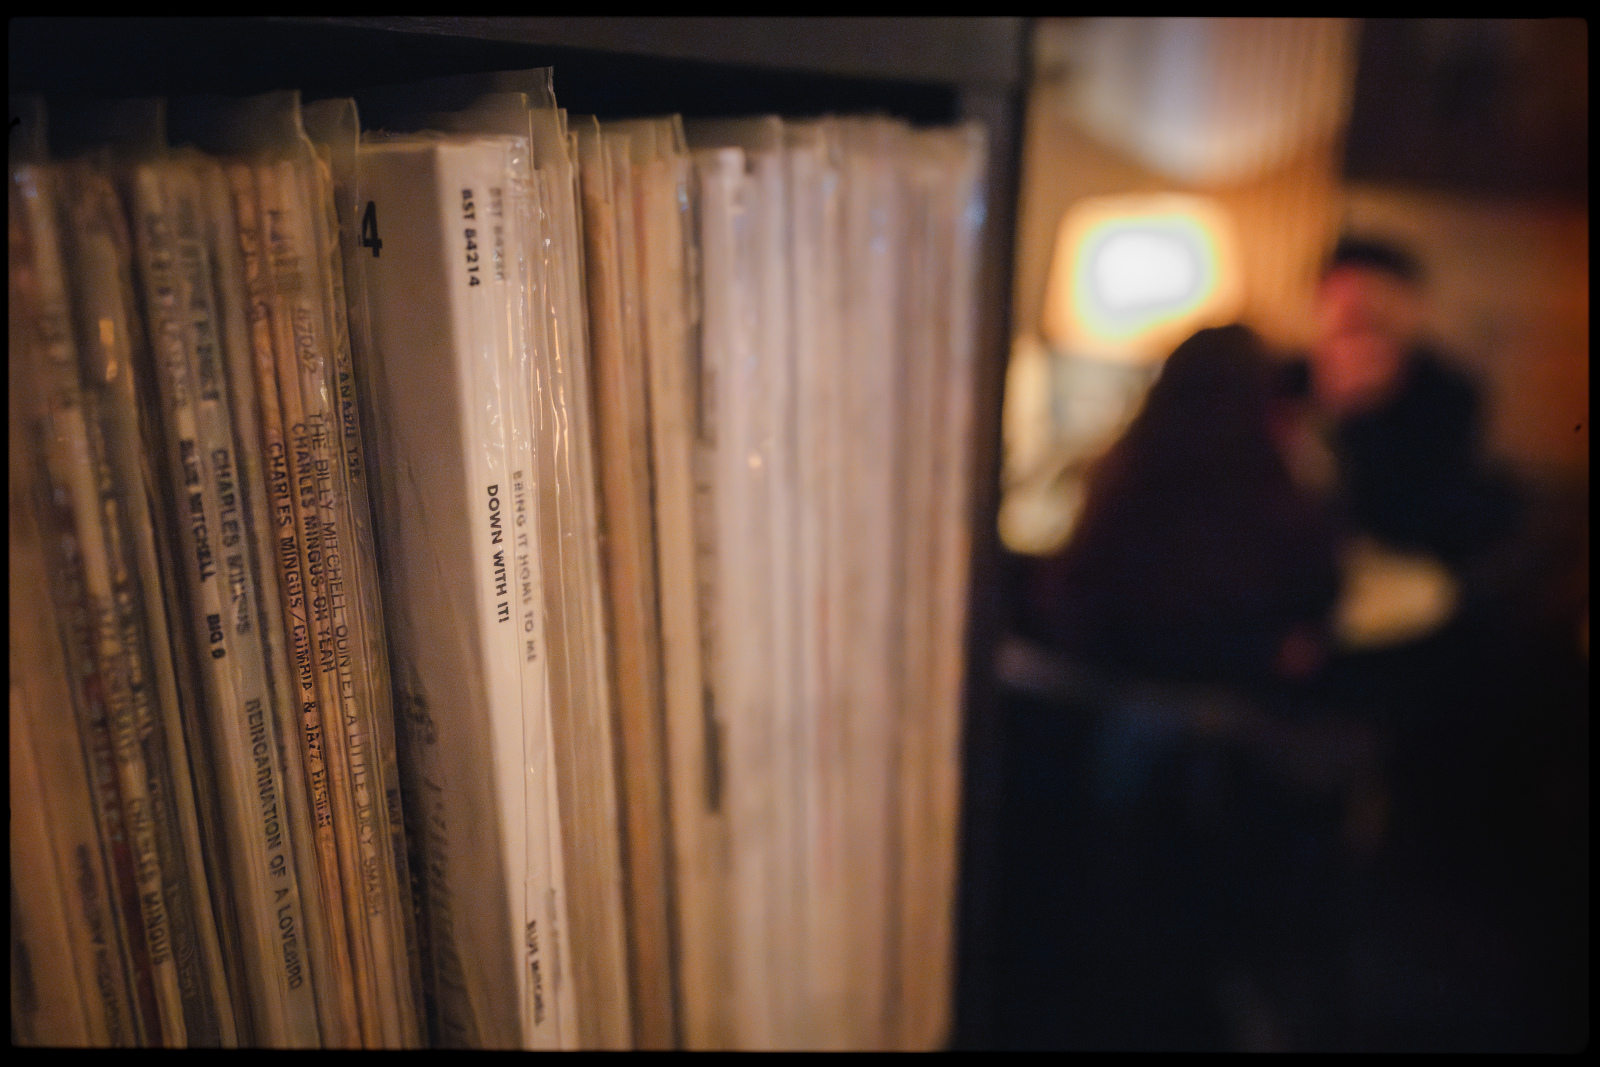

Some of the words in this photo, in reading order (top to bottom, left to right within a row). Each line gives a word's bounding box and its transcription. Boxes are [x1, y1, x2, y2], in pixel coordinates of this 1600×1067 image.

[463, 228, 481, 286] 84214
[309, 410, 327, 451] THE
[211, 448, 241, 548] CHARLES
[269, 443, 293, 527] CHARLES
[314, 459, 334, 510] BILLY
[513, 470, 527, 528] BRING
[487, 484, 504, 545] DOWN
[517, 533, 528, 547] IT
[291, 423, 313, 508] CHARLES
[318, 626, 336, 673] YEAH
[322, 521, 346, 618] MITCHELL
[492, 549, 508, 597] WITH
[517, 554, 534, 606] HOME
[497, 601, 510, 624] IT!
[524, 611, 535, 633] TO
[526, 639, 538, 663] ME
[302, 701, 316, 713] &
[306, 723, 323, 761] JAZZ
[244, 699, 283, 852] REINCARNATION
[269, 854, 287, 877] OF
[275, 887, 290, 902] A
[278, 904, 304, 990] LOVEBIRD
